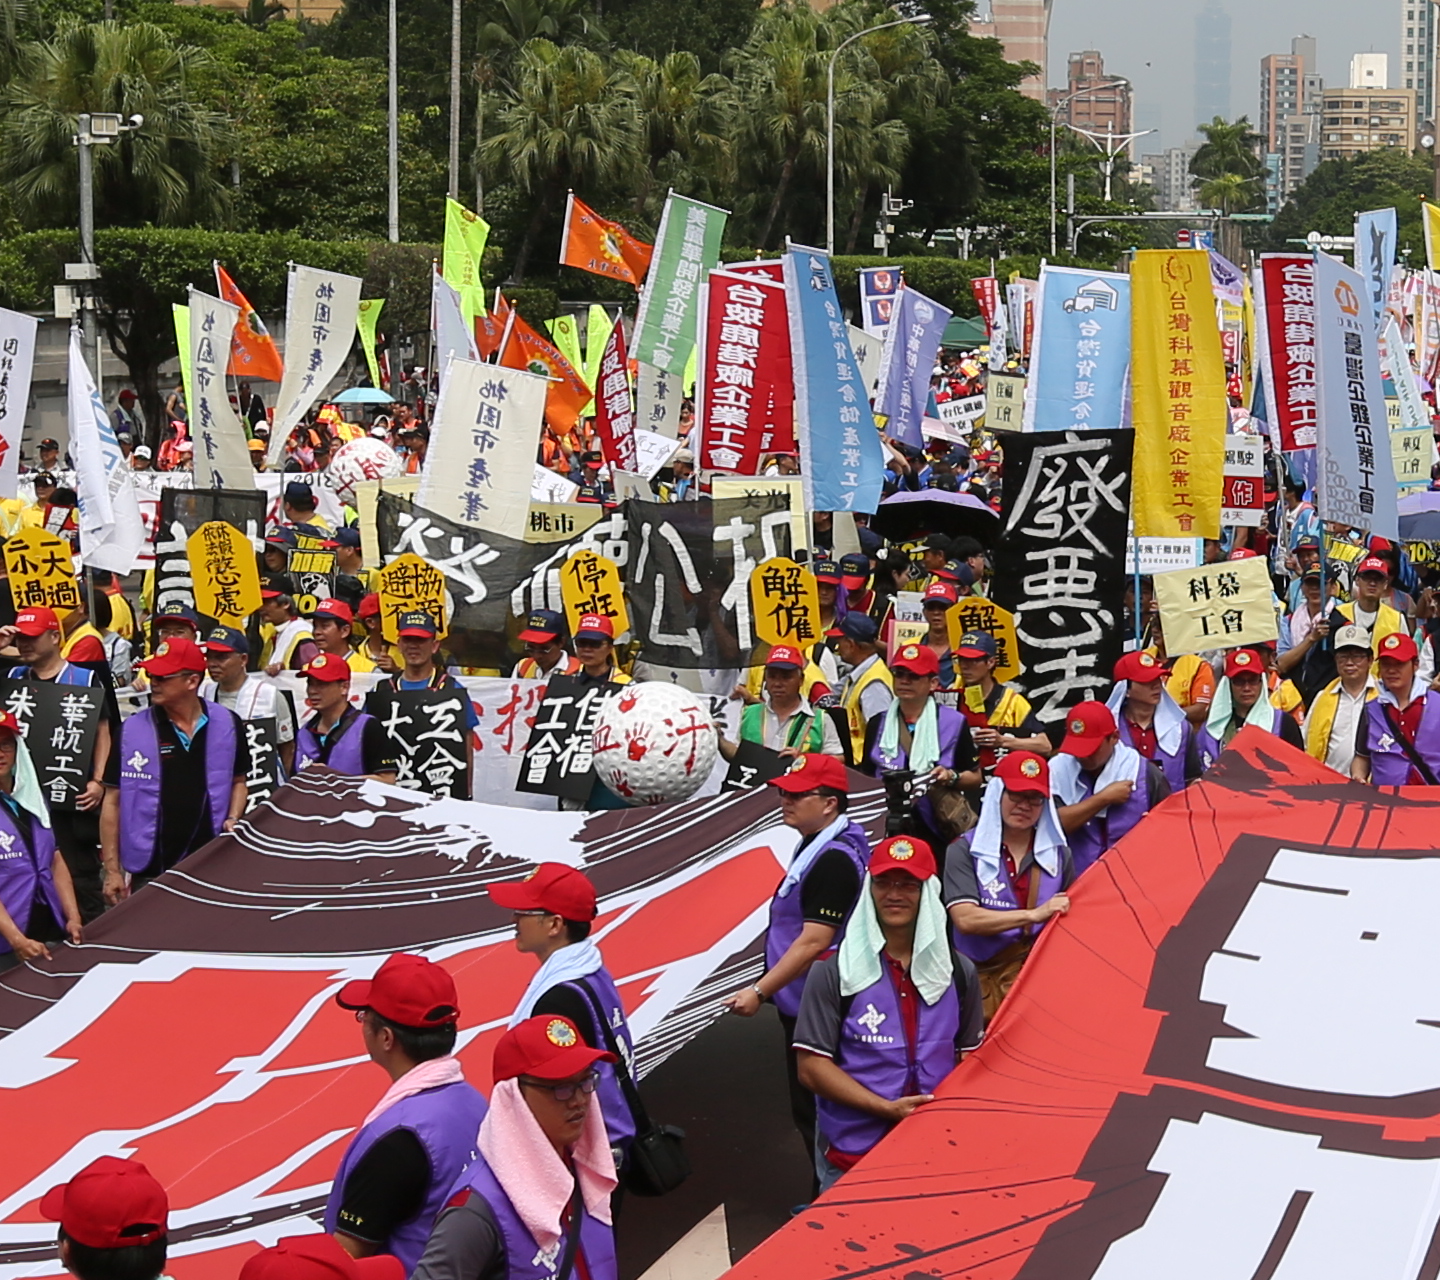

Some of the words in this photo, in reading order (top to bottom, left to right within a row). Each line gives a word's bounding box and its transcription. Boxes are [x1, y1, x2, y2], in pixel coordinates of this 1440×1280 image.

[1168, 291, 1196, 532] 台灣科慕觀音廠企業工會
[1401, 457, 1421, 474] 工會
[530, 510, 575, 534] 桃市
[289, 551, 333, 573] 加薪
[1187, 571, 1241, 602] 科慕
[1194, 607, 1244, 639] 工會
[43, 693, 95, 803] 華航工會
[526, 697, 573, 784] 工會
